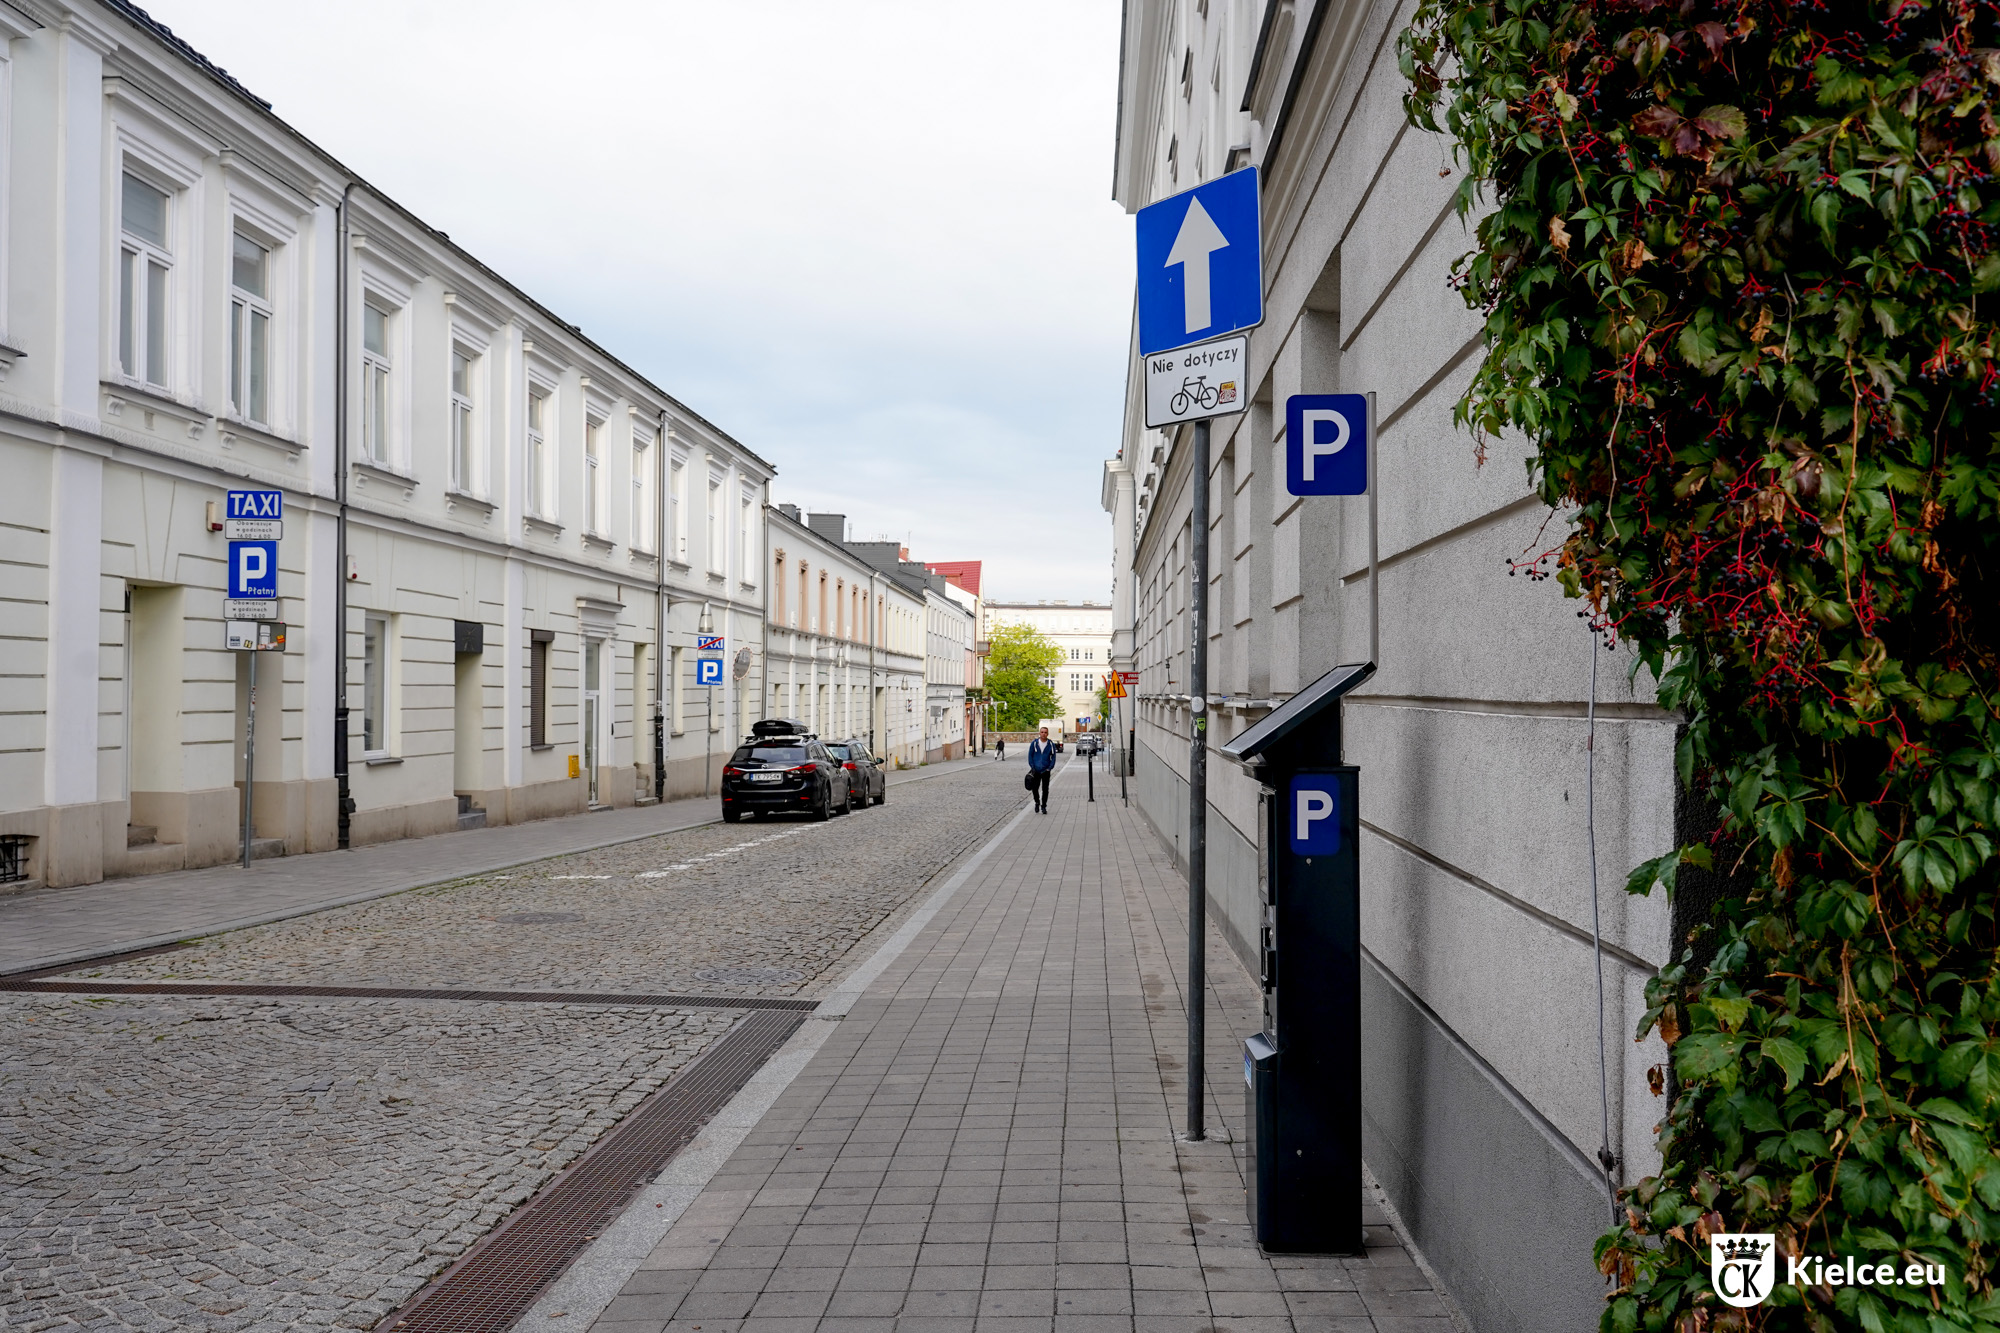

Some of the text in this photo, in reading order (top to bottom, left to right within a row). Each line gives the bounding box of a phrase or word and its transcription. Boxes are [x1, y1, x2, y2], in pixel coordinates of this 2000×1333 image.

[1153, 347, 1239, 374] Nie dotyczy
[1302, 409, 1351, 481] P
[230, 493, 279, 516] TAXI
[239, 547, 267, 592] P
[247, 586, 275, 597] Płatny
[699, 637, 724, 649] TAXI
[702, 661, 718, 682] P
[1297, 790, 1333, 839] P
